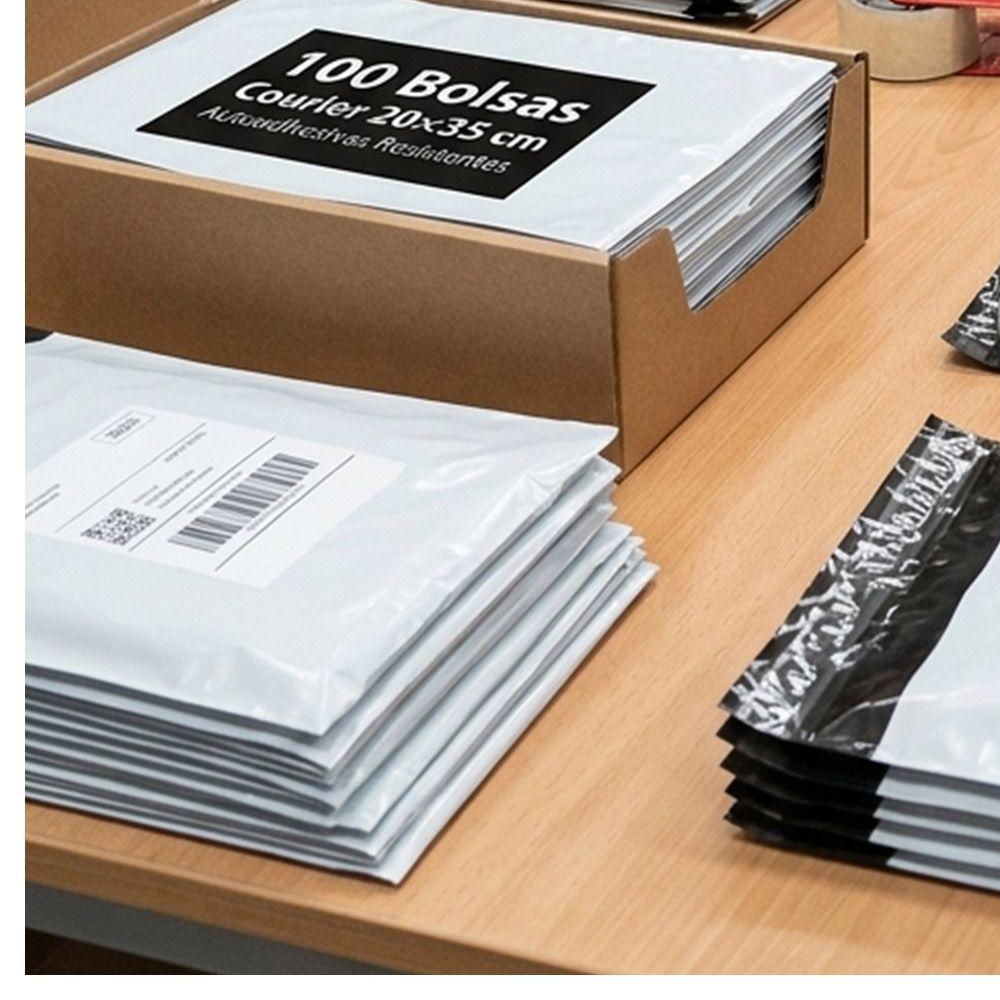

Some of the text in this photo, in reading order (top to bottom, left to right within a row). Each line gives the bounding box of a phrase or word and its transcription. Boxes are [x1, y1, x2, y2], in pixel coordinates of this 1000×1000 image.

[286, 52, 591, 123] 100 Bolsas
[367, 105, 493, 140] 20x35
[489, 131, 548, 152] cm
